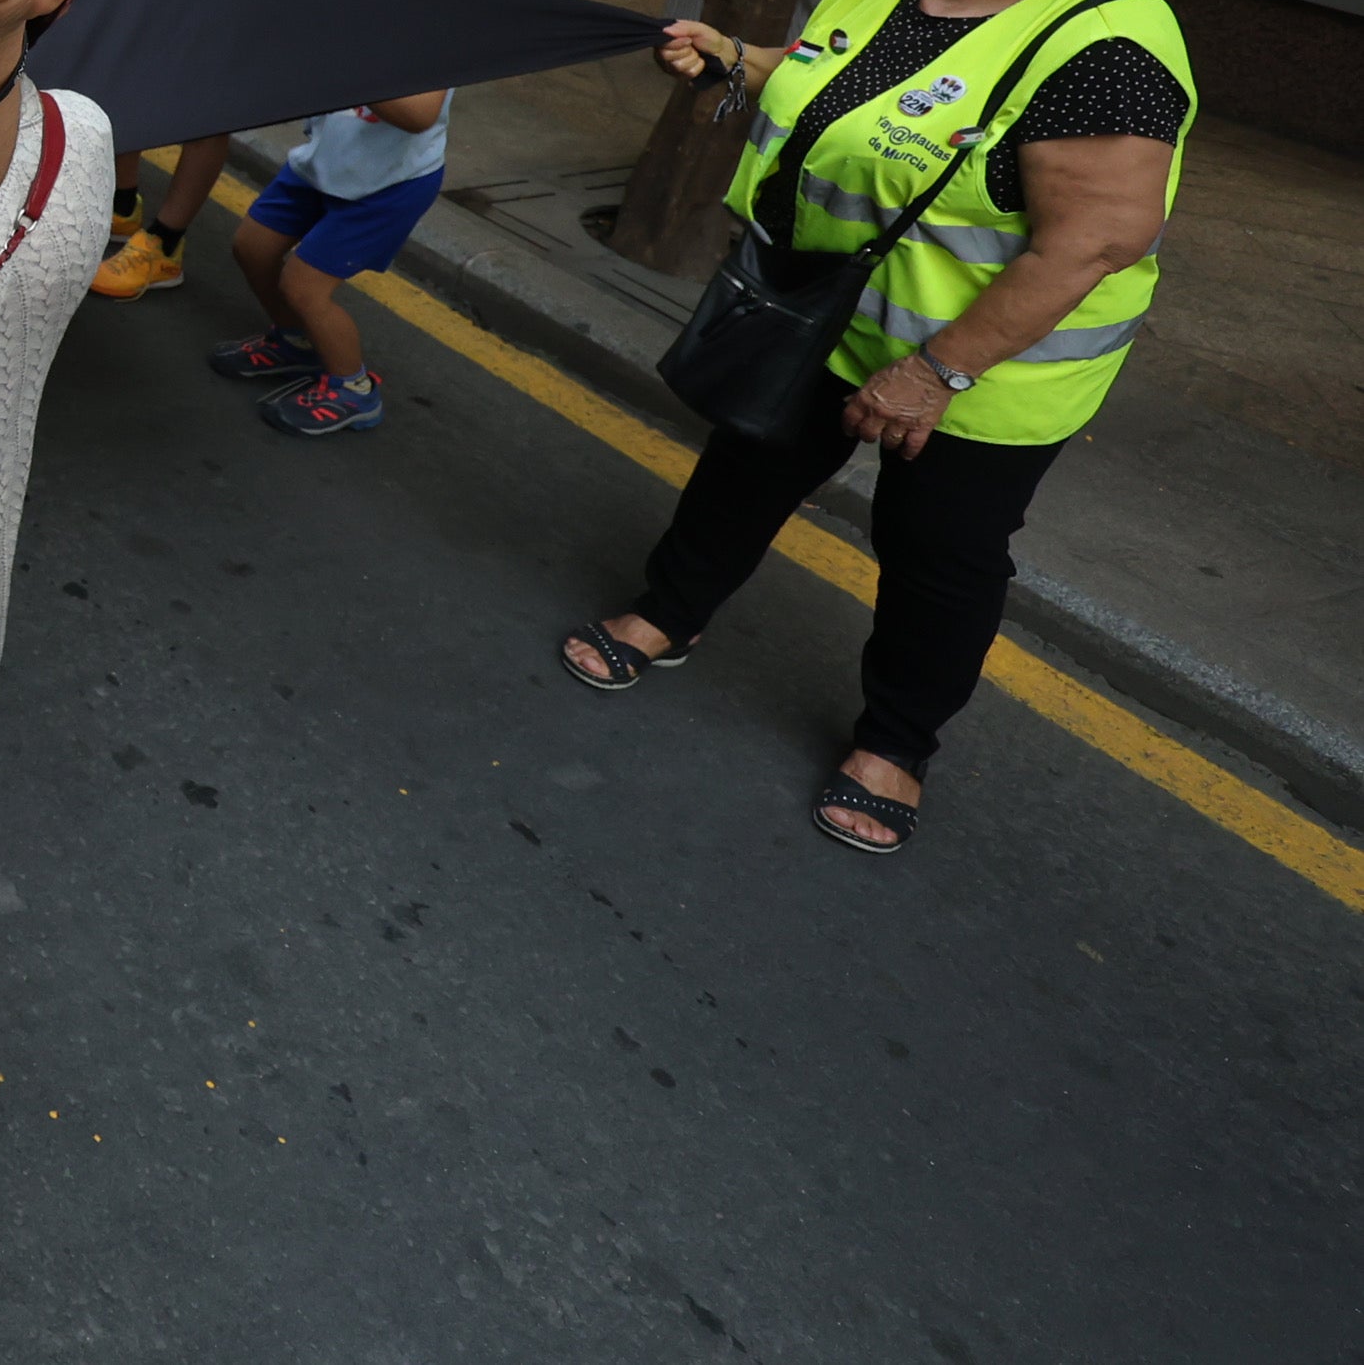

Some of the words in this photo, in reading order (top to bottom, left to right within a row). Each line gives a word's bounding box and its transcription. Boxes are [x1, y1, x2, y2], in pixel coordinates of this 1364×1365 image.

[900, 93, 932, 115] 22M
[868, 136, 882, 151] de
[880, 146, 929, 173] Murcia
[875, 115, 952, 162] Yay@flautas
